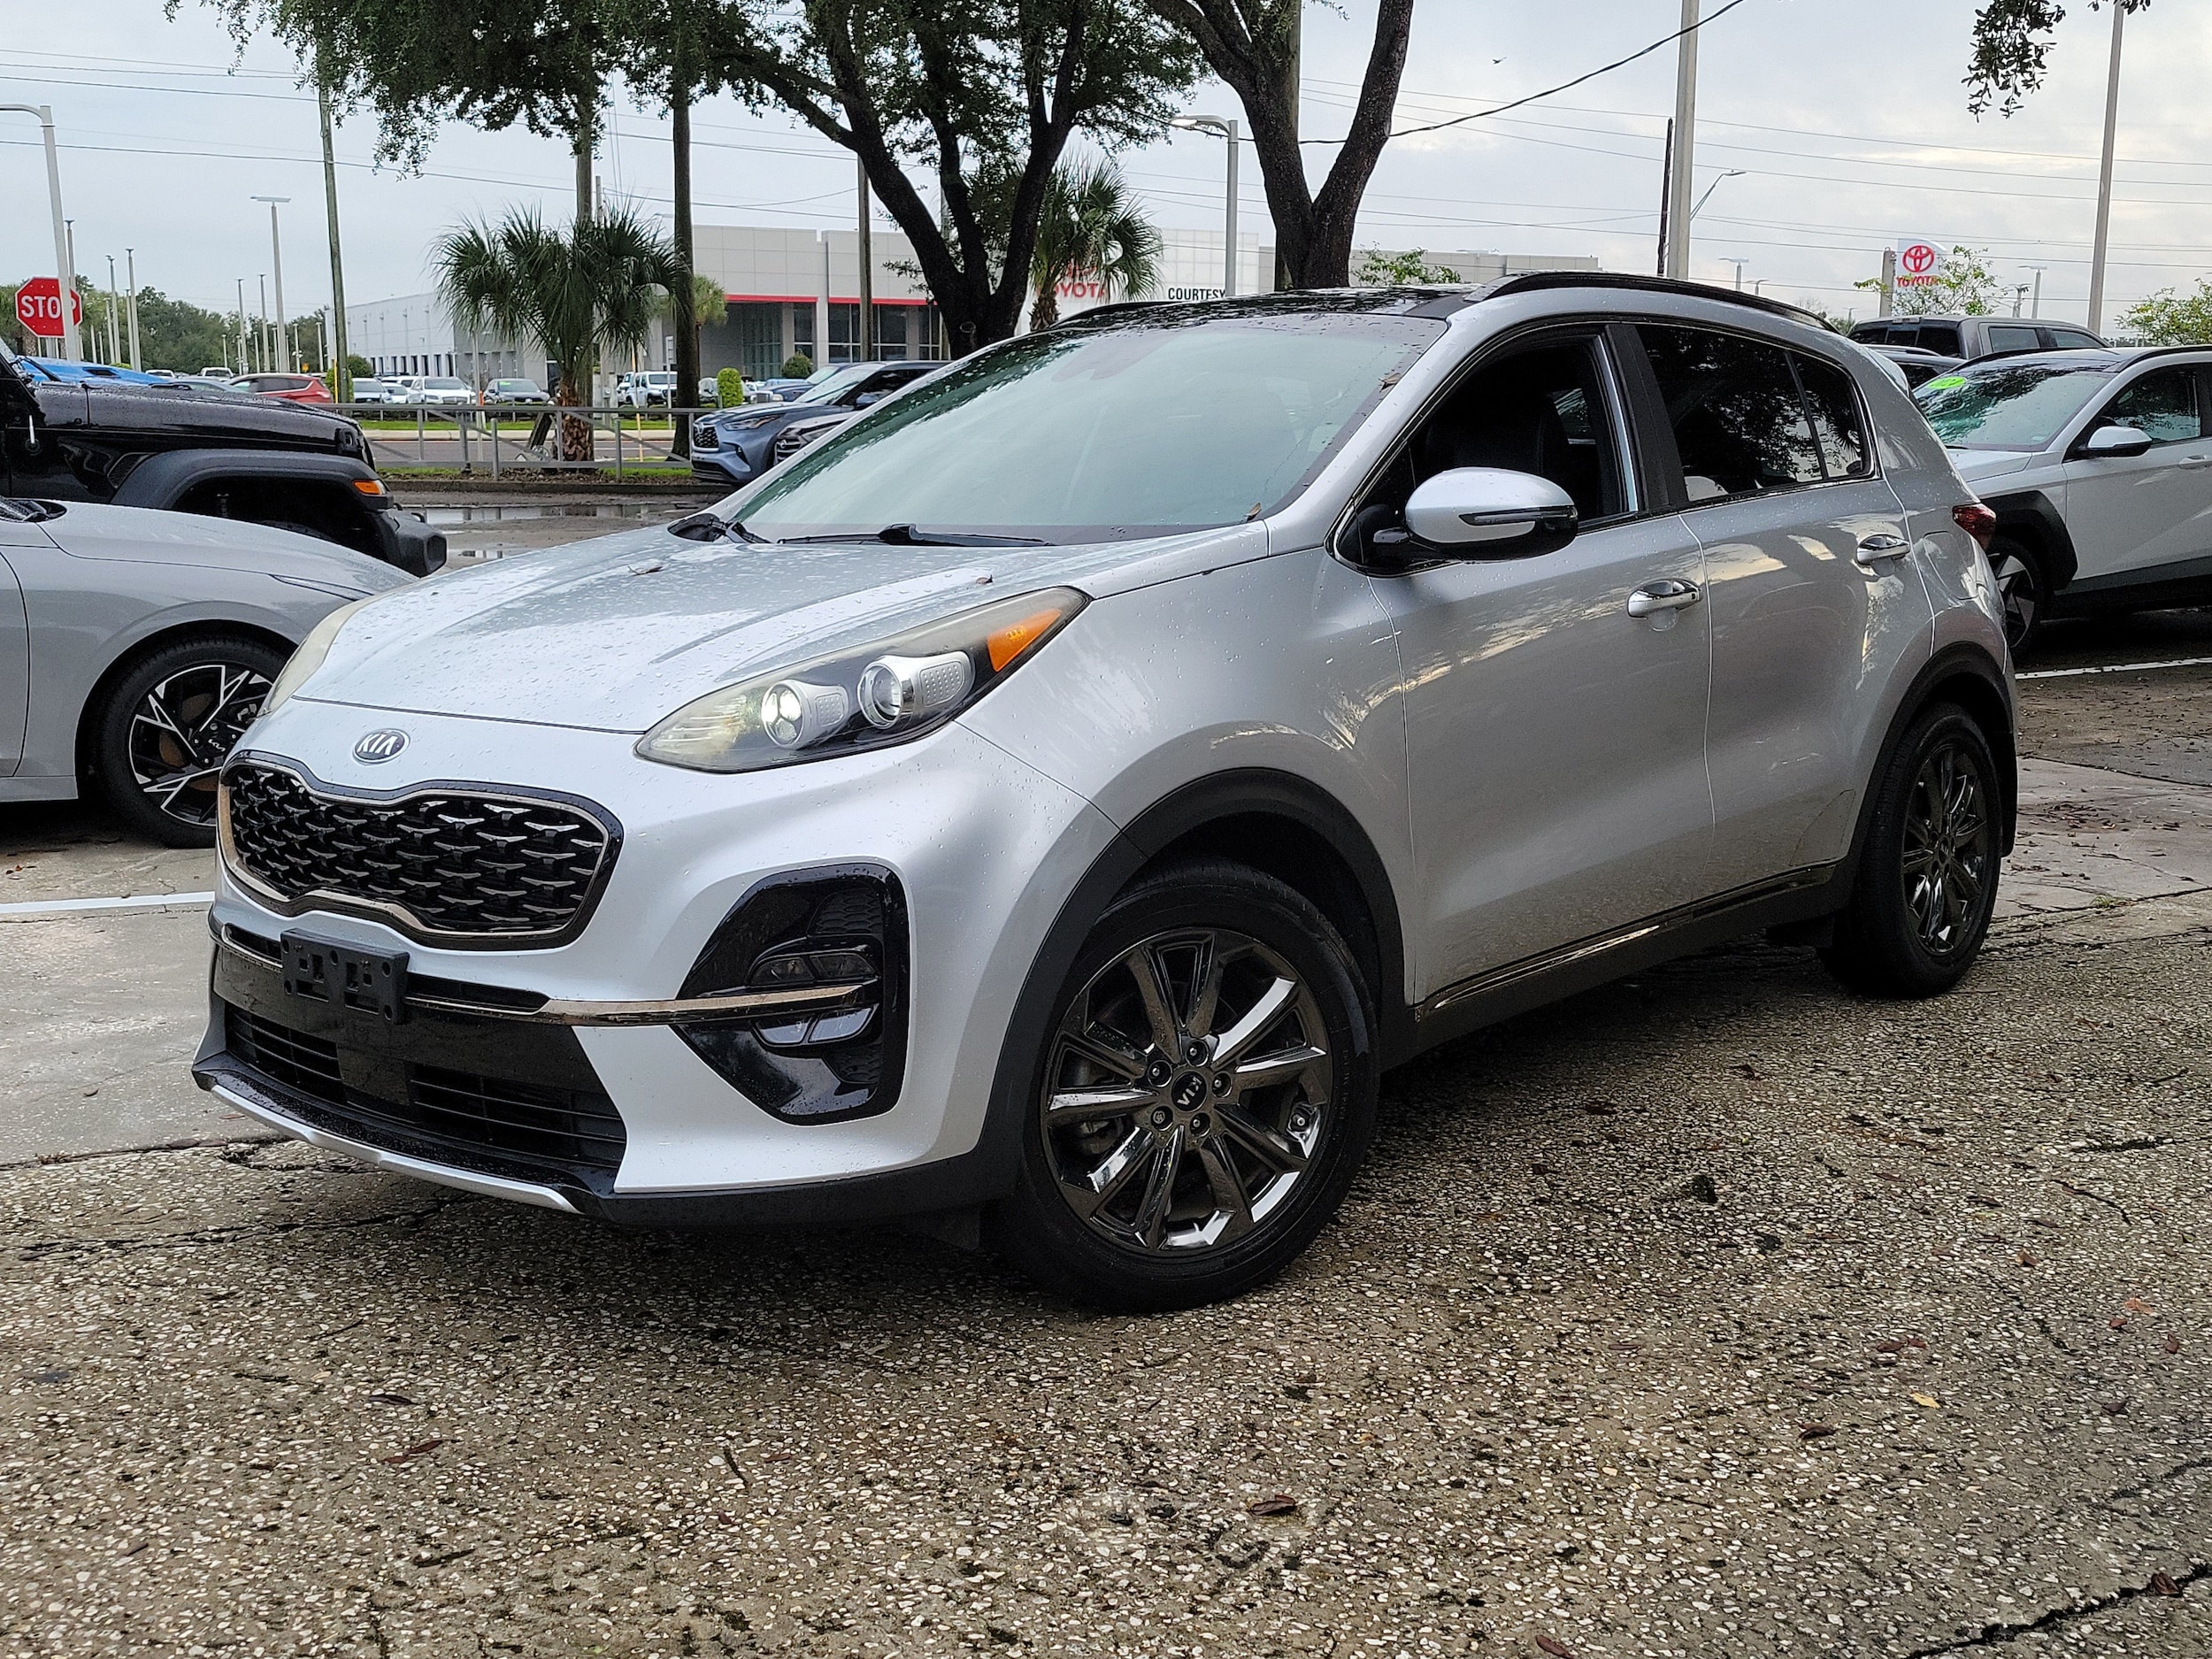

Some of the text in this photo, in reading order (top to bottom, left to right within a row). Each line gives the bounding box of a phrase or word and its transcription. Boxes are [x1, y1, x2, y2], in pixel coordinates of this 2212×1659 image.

[1037, 282, 1105, 297] YOT
[1168, 288, 1225, 301] COURTESY
[356, 733, 398, 756] KIA
[1177, 1076, 1202, 1105] KIA
